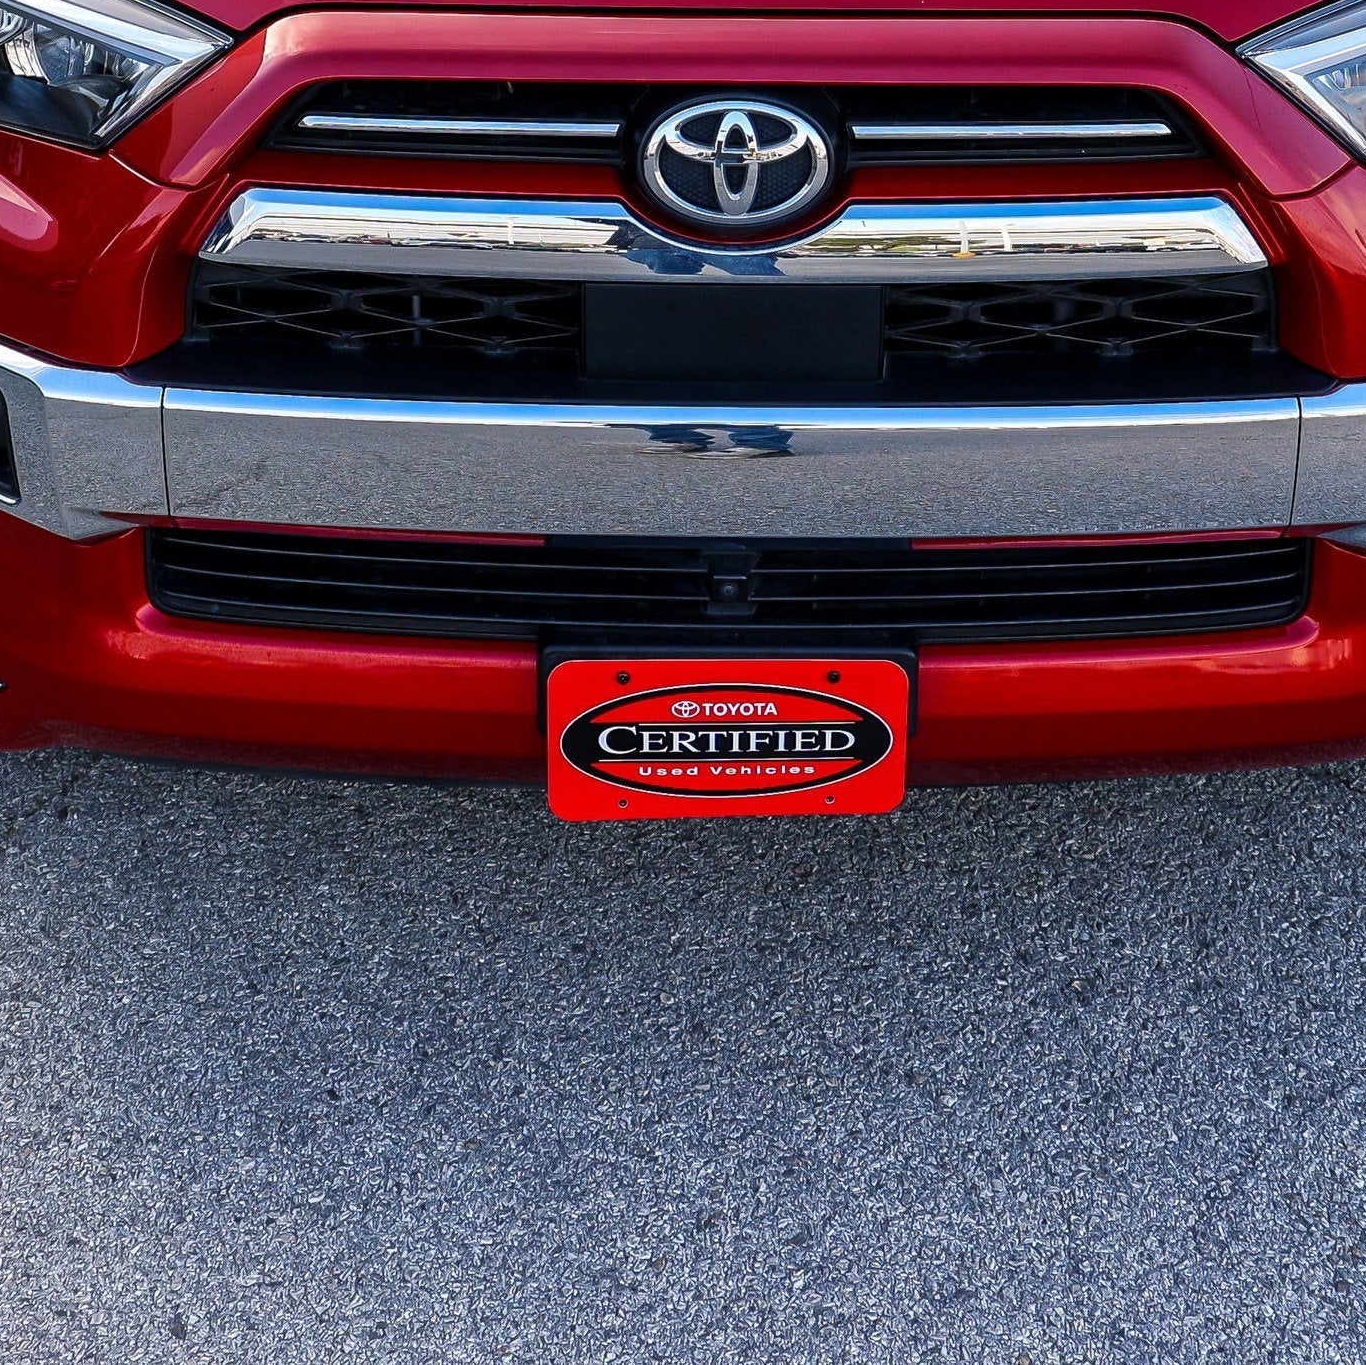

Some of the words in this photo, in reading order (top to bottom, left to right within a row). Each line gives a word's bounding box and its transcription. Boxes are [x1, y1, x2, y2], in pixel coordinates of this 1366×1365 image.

[701, 702, 778, 717] TOYOTA
[598, 725, 856, 755] CERTIFIED
[638, 766, 699, 776] Used
[709, 765, 816, 776] Vehicles
